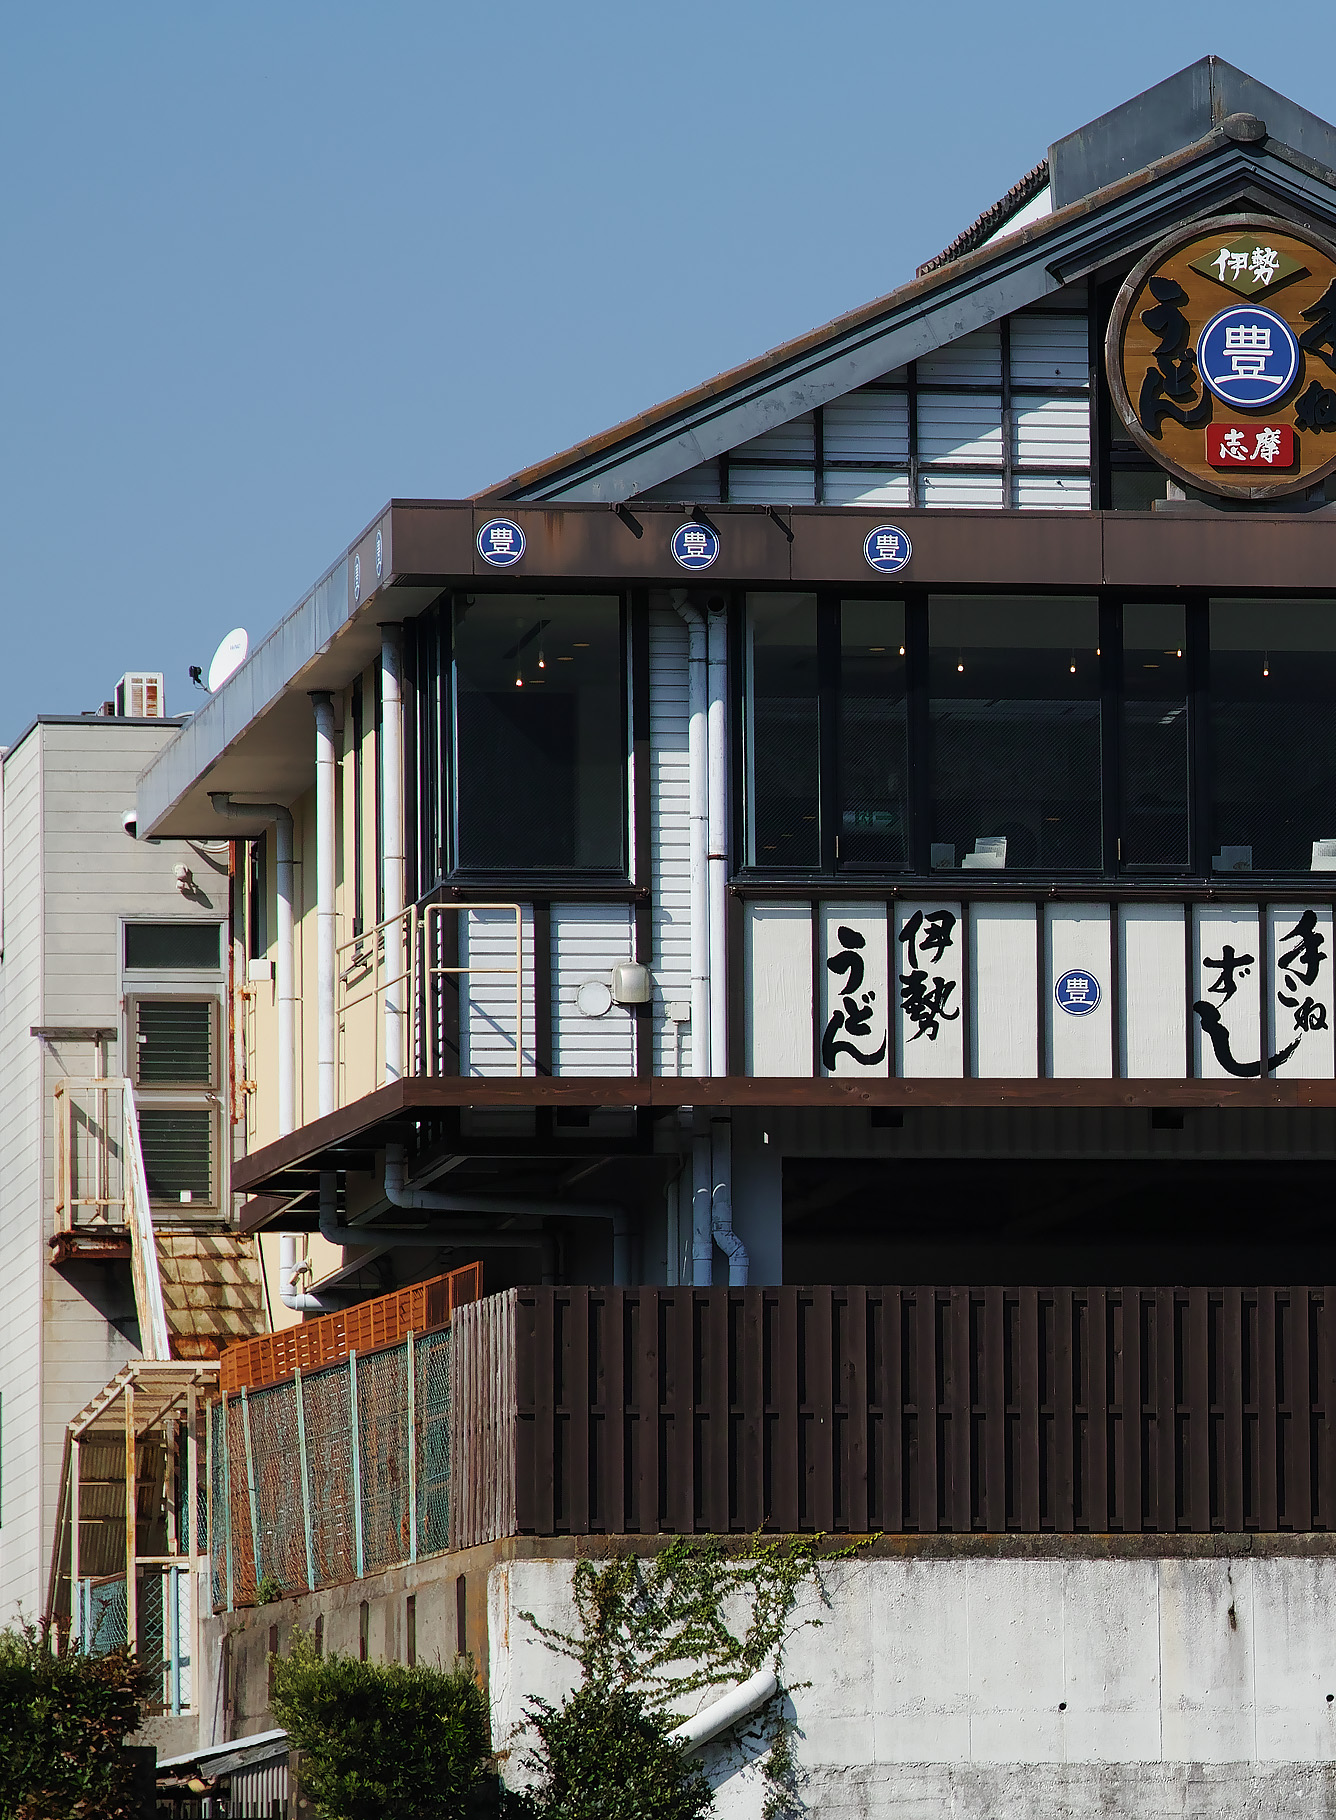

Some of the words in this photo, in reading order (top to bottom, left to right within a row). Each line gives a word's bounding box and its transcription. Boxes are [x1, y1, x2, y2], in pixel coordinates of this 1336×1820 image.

[1210, 246, 1280, 286] 伊勢
[1139, 276, 1213, 440] うどん
[1212, 323, 1285, 385] 豊
[1218, 427, 1282, 463] 志摩
[482, 526, 520, 559] 豊
[676, 529, 715, 563] 豊
[868, 532, 908, 564] 豊
[899, 909, 960, 1043] 伊勢
[1060, 976, 1096, 1008] 豊
[1276, 909, 1329, 1033] 手こね
[821, 926, 887, 1071] うどん
[1192, 945, 1303, 1078] ずし
